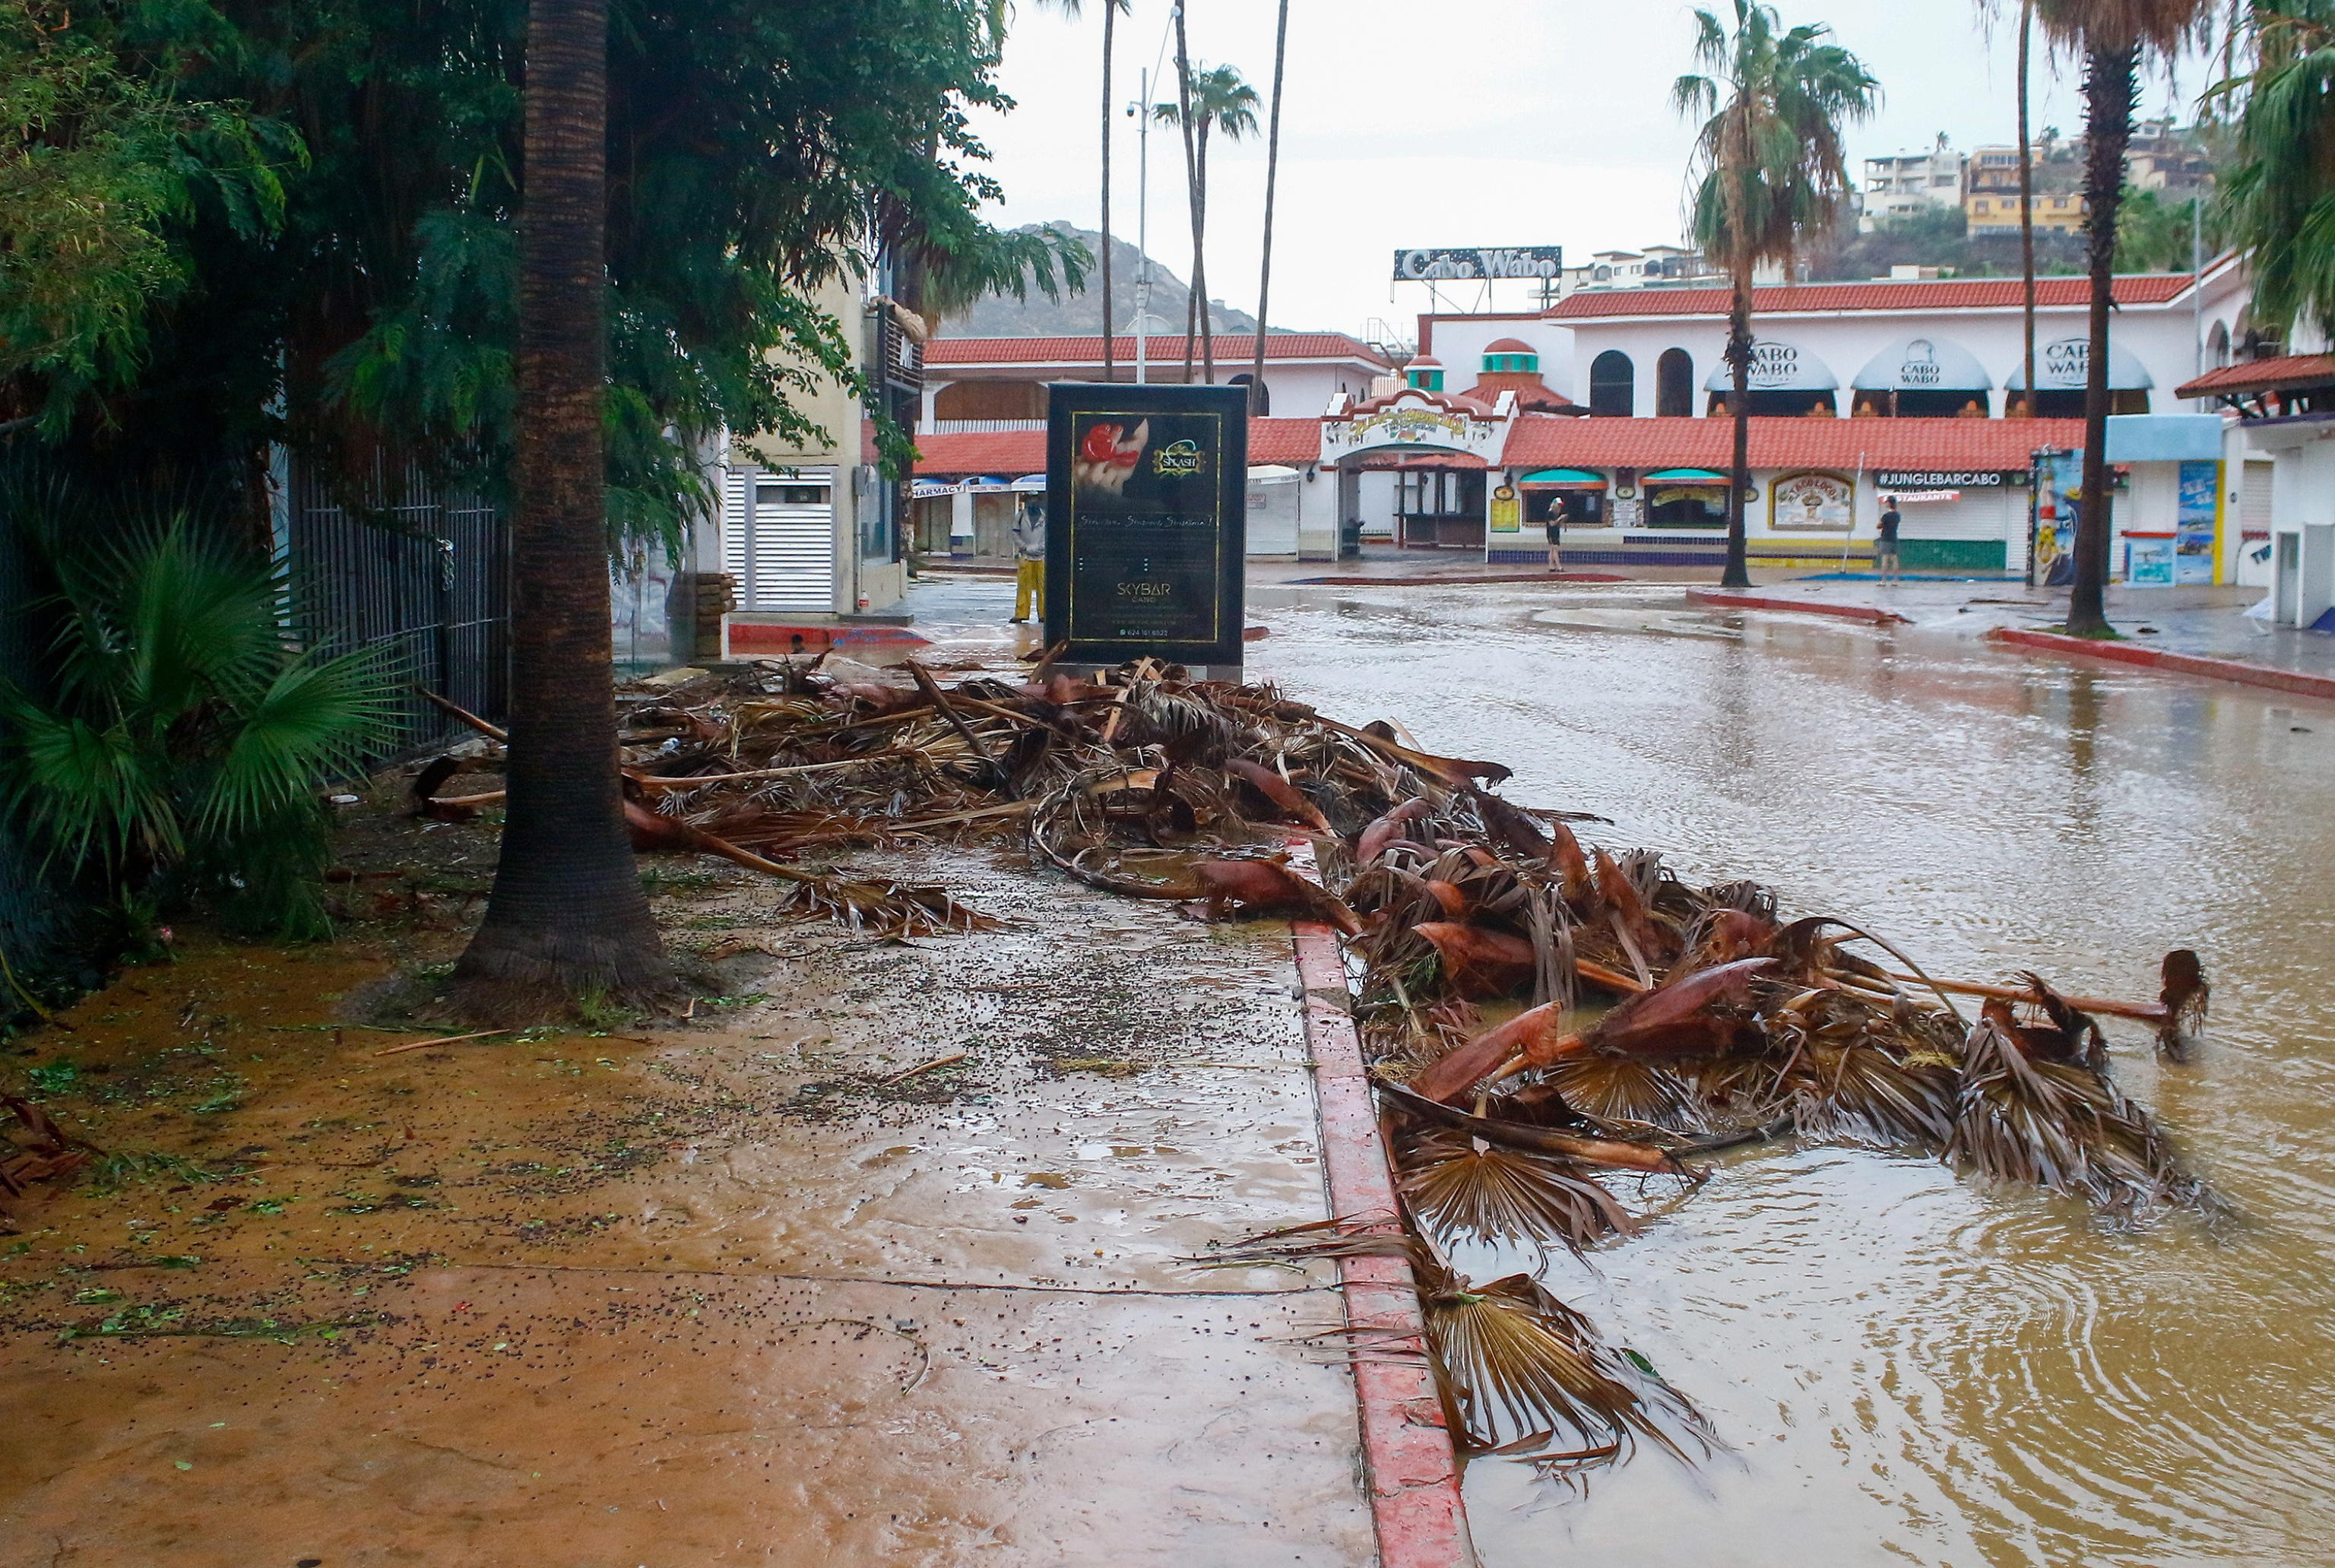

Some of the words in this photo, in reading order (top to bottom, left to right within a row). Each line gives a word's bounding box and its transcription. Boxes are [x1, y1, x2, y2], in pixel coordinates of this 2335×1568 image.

[1402, 250, 1475, 279] Cabo
[1477, 249, 1557, 279] Wabo
[1752, 347, 1798, 362] ABO
[2046, 344, 2089, 360] CAB
[1901, 365, 1940, 375] CABO
[1901, 375, 1940, 384] WABO
[1163, 458, 1196, 468] SPLASH
[1879, 473, 2001, 486] #JUNGLEBARCABO
[911, 486, 962, 497] HARMACY
[1882, 494, 1953, 503] RSTAURANTE
[1117, 582, 1171, 596] SKYBAR
